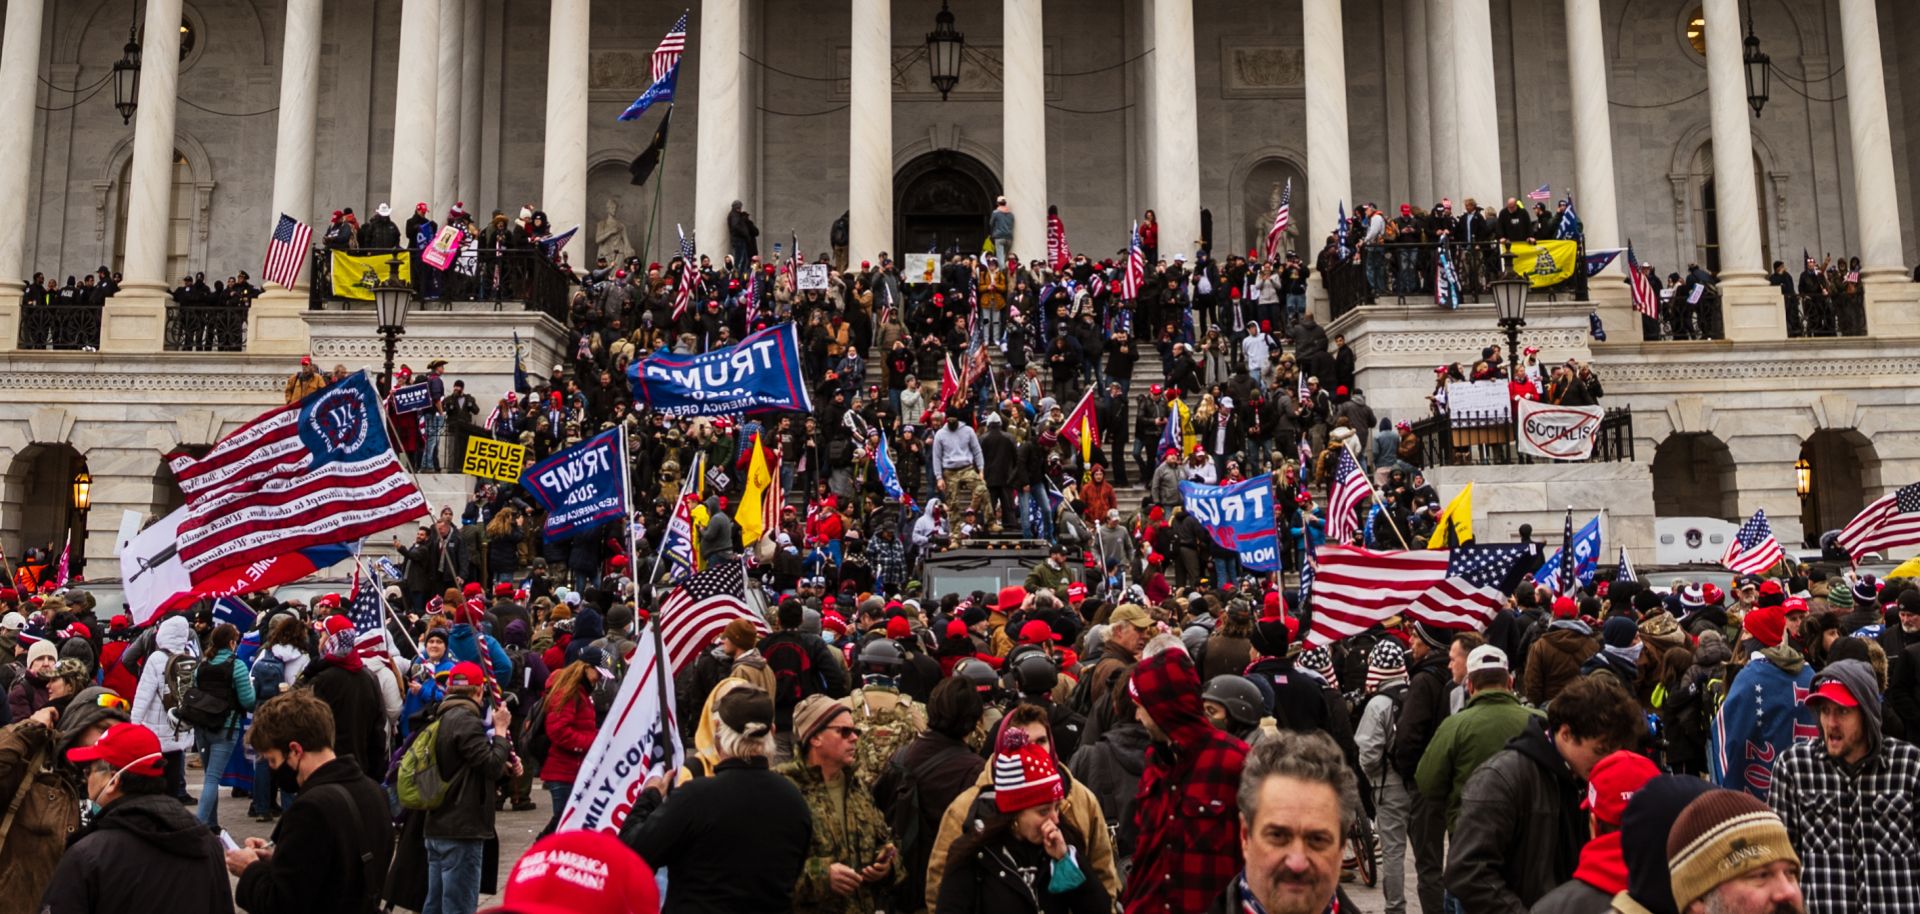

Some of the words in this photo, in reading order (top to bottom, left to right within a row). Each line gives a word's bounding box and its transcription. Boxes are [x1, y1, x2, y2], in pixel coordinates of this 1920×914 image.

[395, 388, 428, 401] TRUMP
[469, 440, 522, 463] JESUS
[465, 456, 519, 479] SAVES
[581, 775, 616, 832] MILY
[546, 848, 609, 878] AMERICA
[1717, 844, 1772, 873] GUINNESS
[555, 864, 605, 892] AGAIN!
